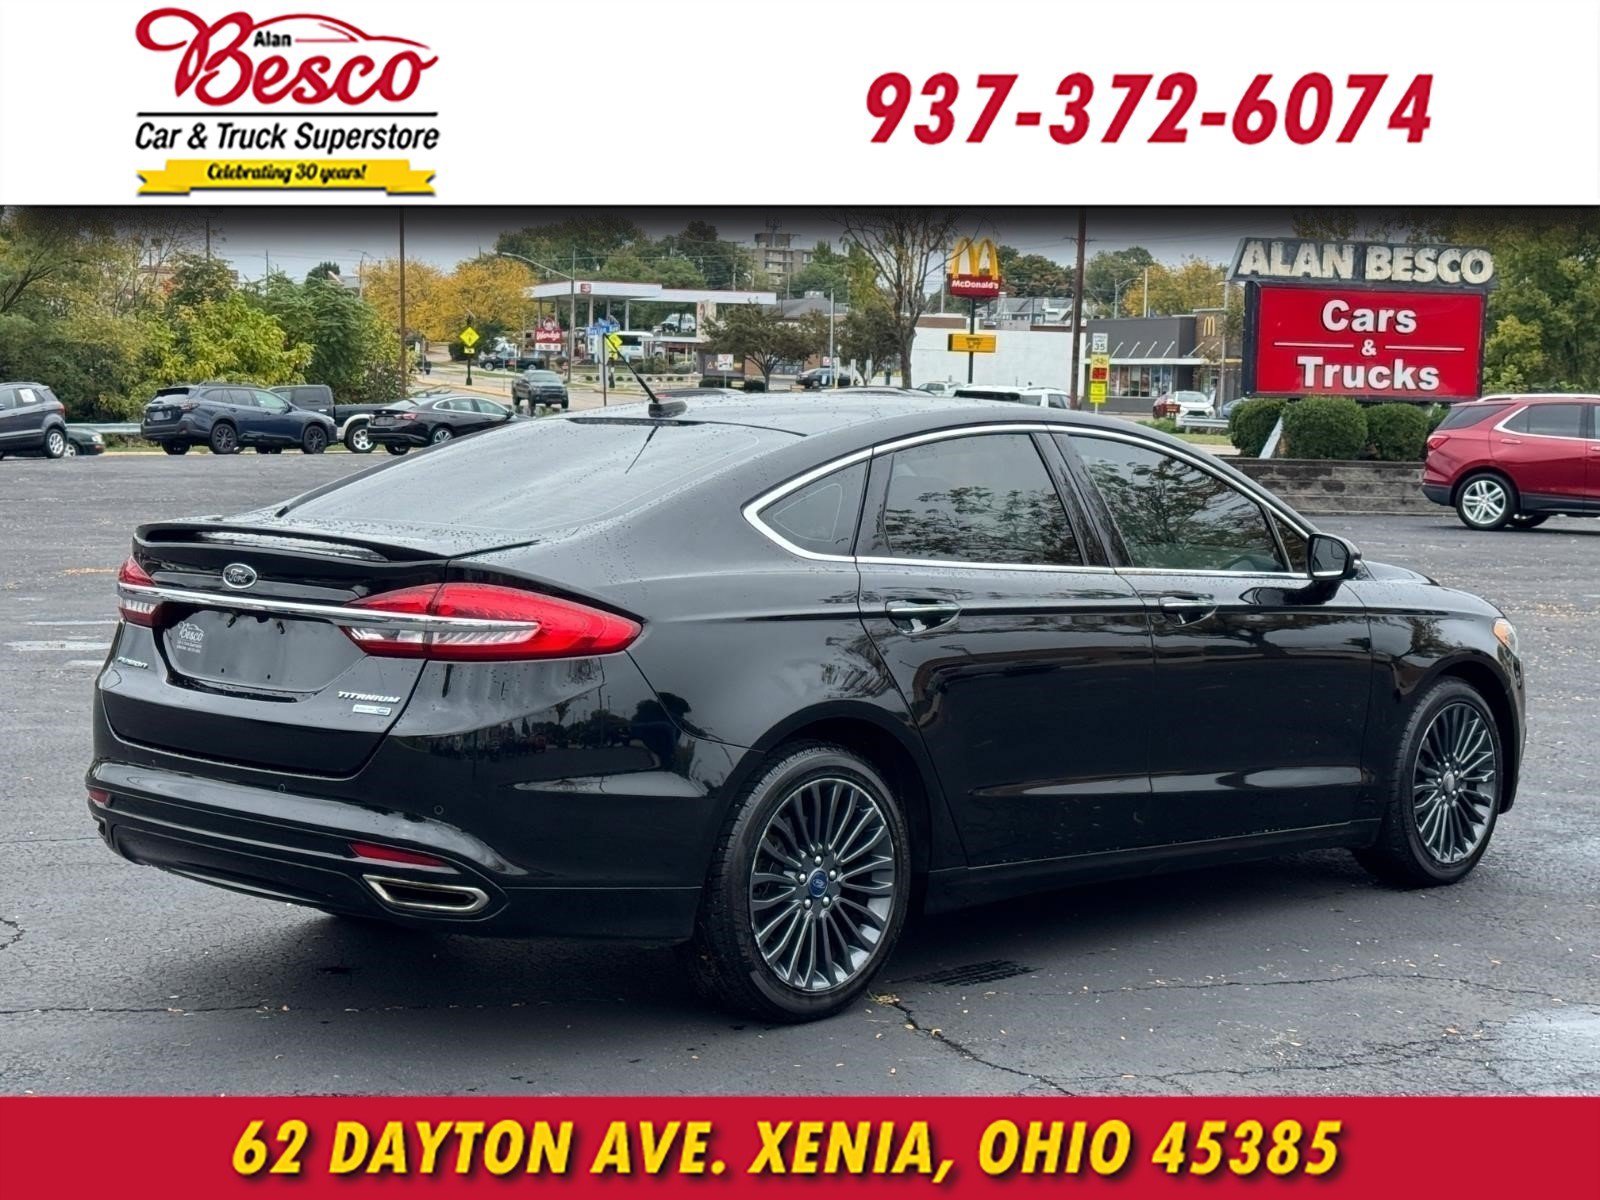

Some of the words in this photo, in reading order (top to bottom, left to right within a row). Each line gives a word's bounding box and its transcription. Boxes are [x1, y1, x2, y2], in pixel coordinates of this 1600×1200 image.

[1238, 240, 1355, 279] ALAN
[1365, 245, 1494, 285] BESCO
[951, 279, 999, 290] McDonald's
[1322, 299, 1418, 334] Cars
[1094, 342, 1106, 351] 35
[1360, 338, 1378, 357] &
[1296, 355, 1441, 391] Trucks
[337, 690, 401, 703] TITANIUM
